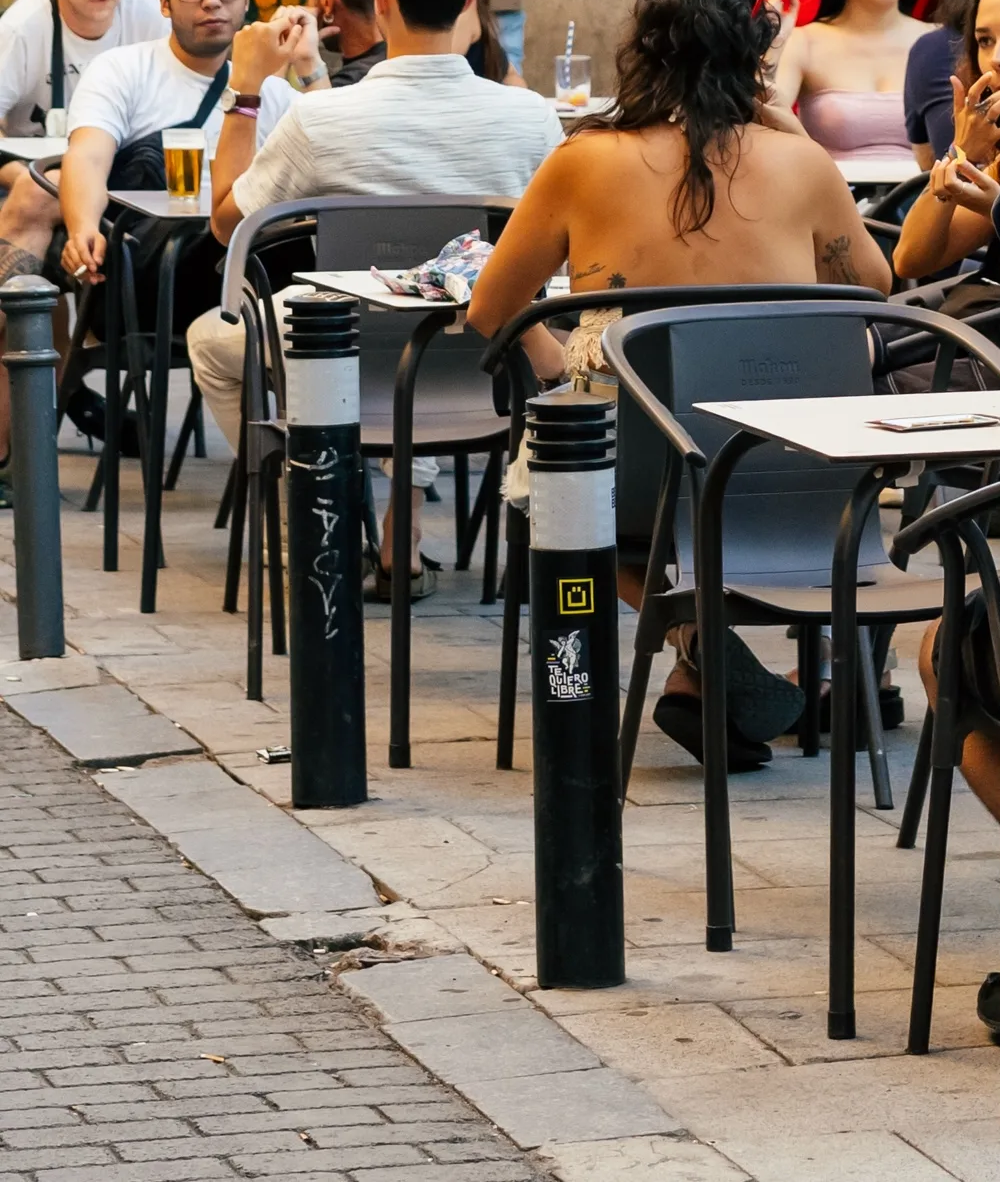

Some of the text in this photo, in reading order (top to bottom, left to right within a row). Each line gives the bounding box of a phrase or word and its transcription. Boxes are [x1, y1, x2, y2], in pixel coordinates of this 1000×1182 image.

[548, 665, 562, 676] TE
[549, 671, 588, 688] QUIERO
[551, 683, 583, 698] LIBRE
